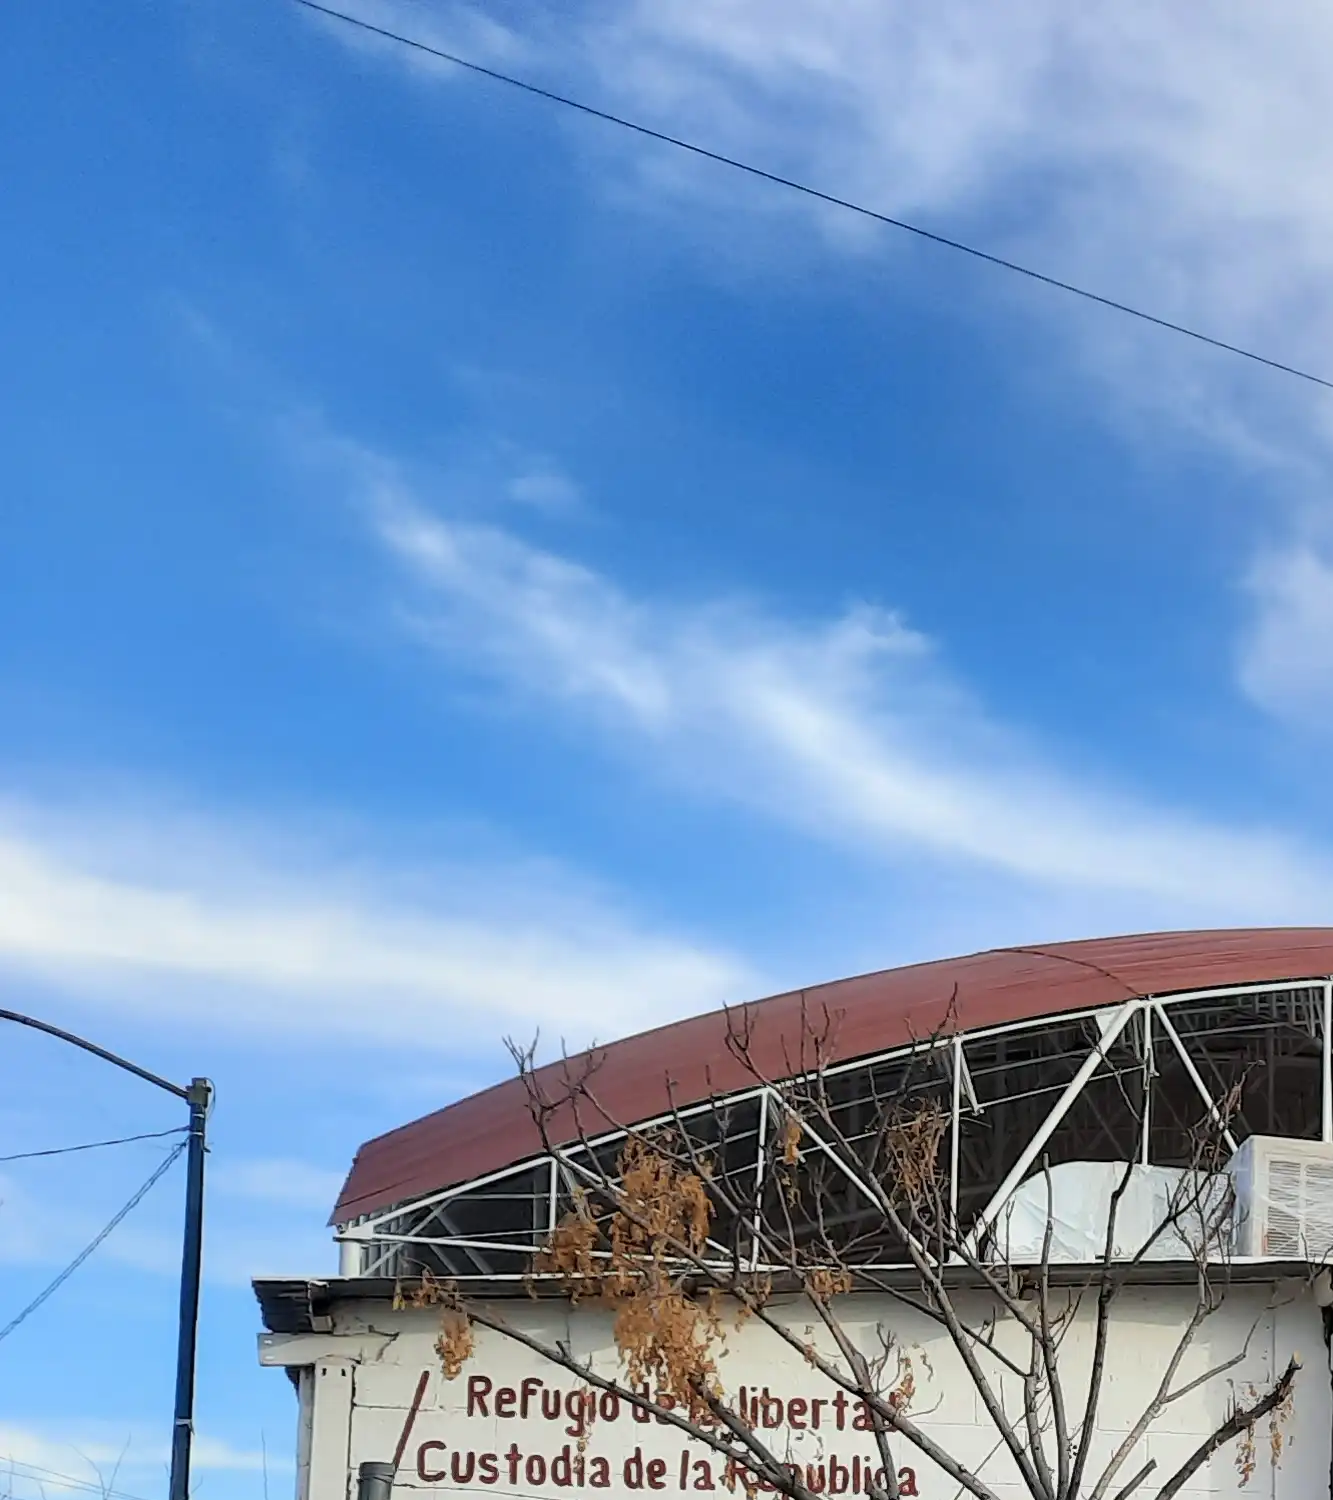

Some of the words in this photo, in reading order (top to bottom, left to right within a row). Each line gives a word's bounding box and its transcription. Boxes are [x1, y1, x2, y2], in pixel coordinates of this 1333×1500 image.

[466, 1375, 622, 1437] Refugio
[416, 1440, 610, 1488] Custodia
[623, 1446, 668, 1491] de
[679, 1449, 716, 1492] la
